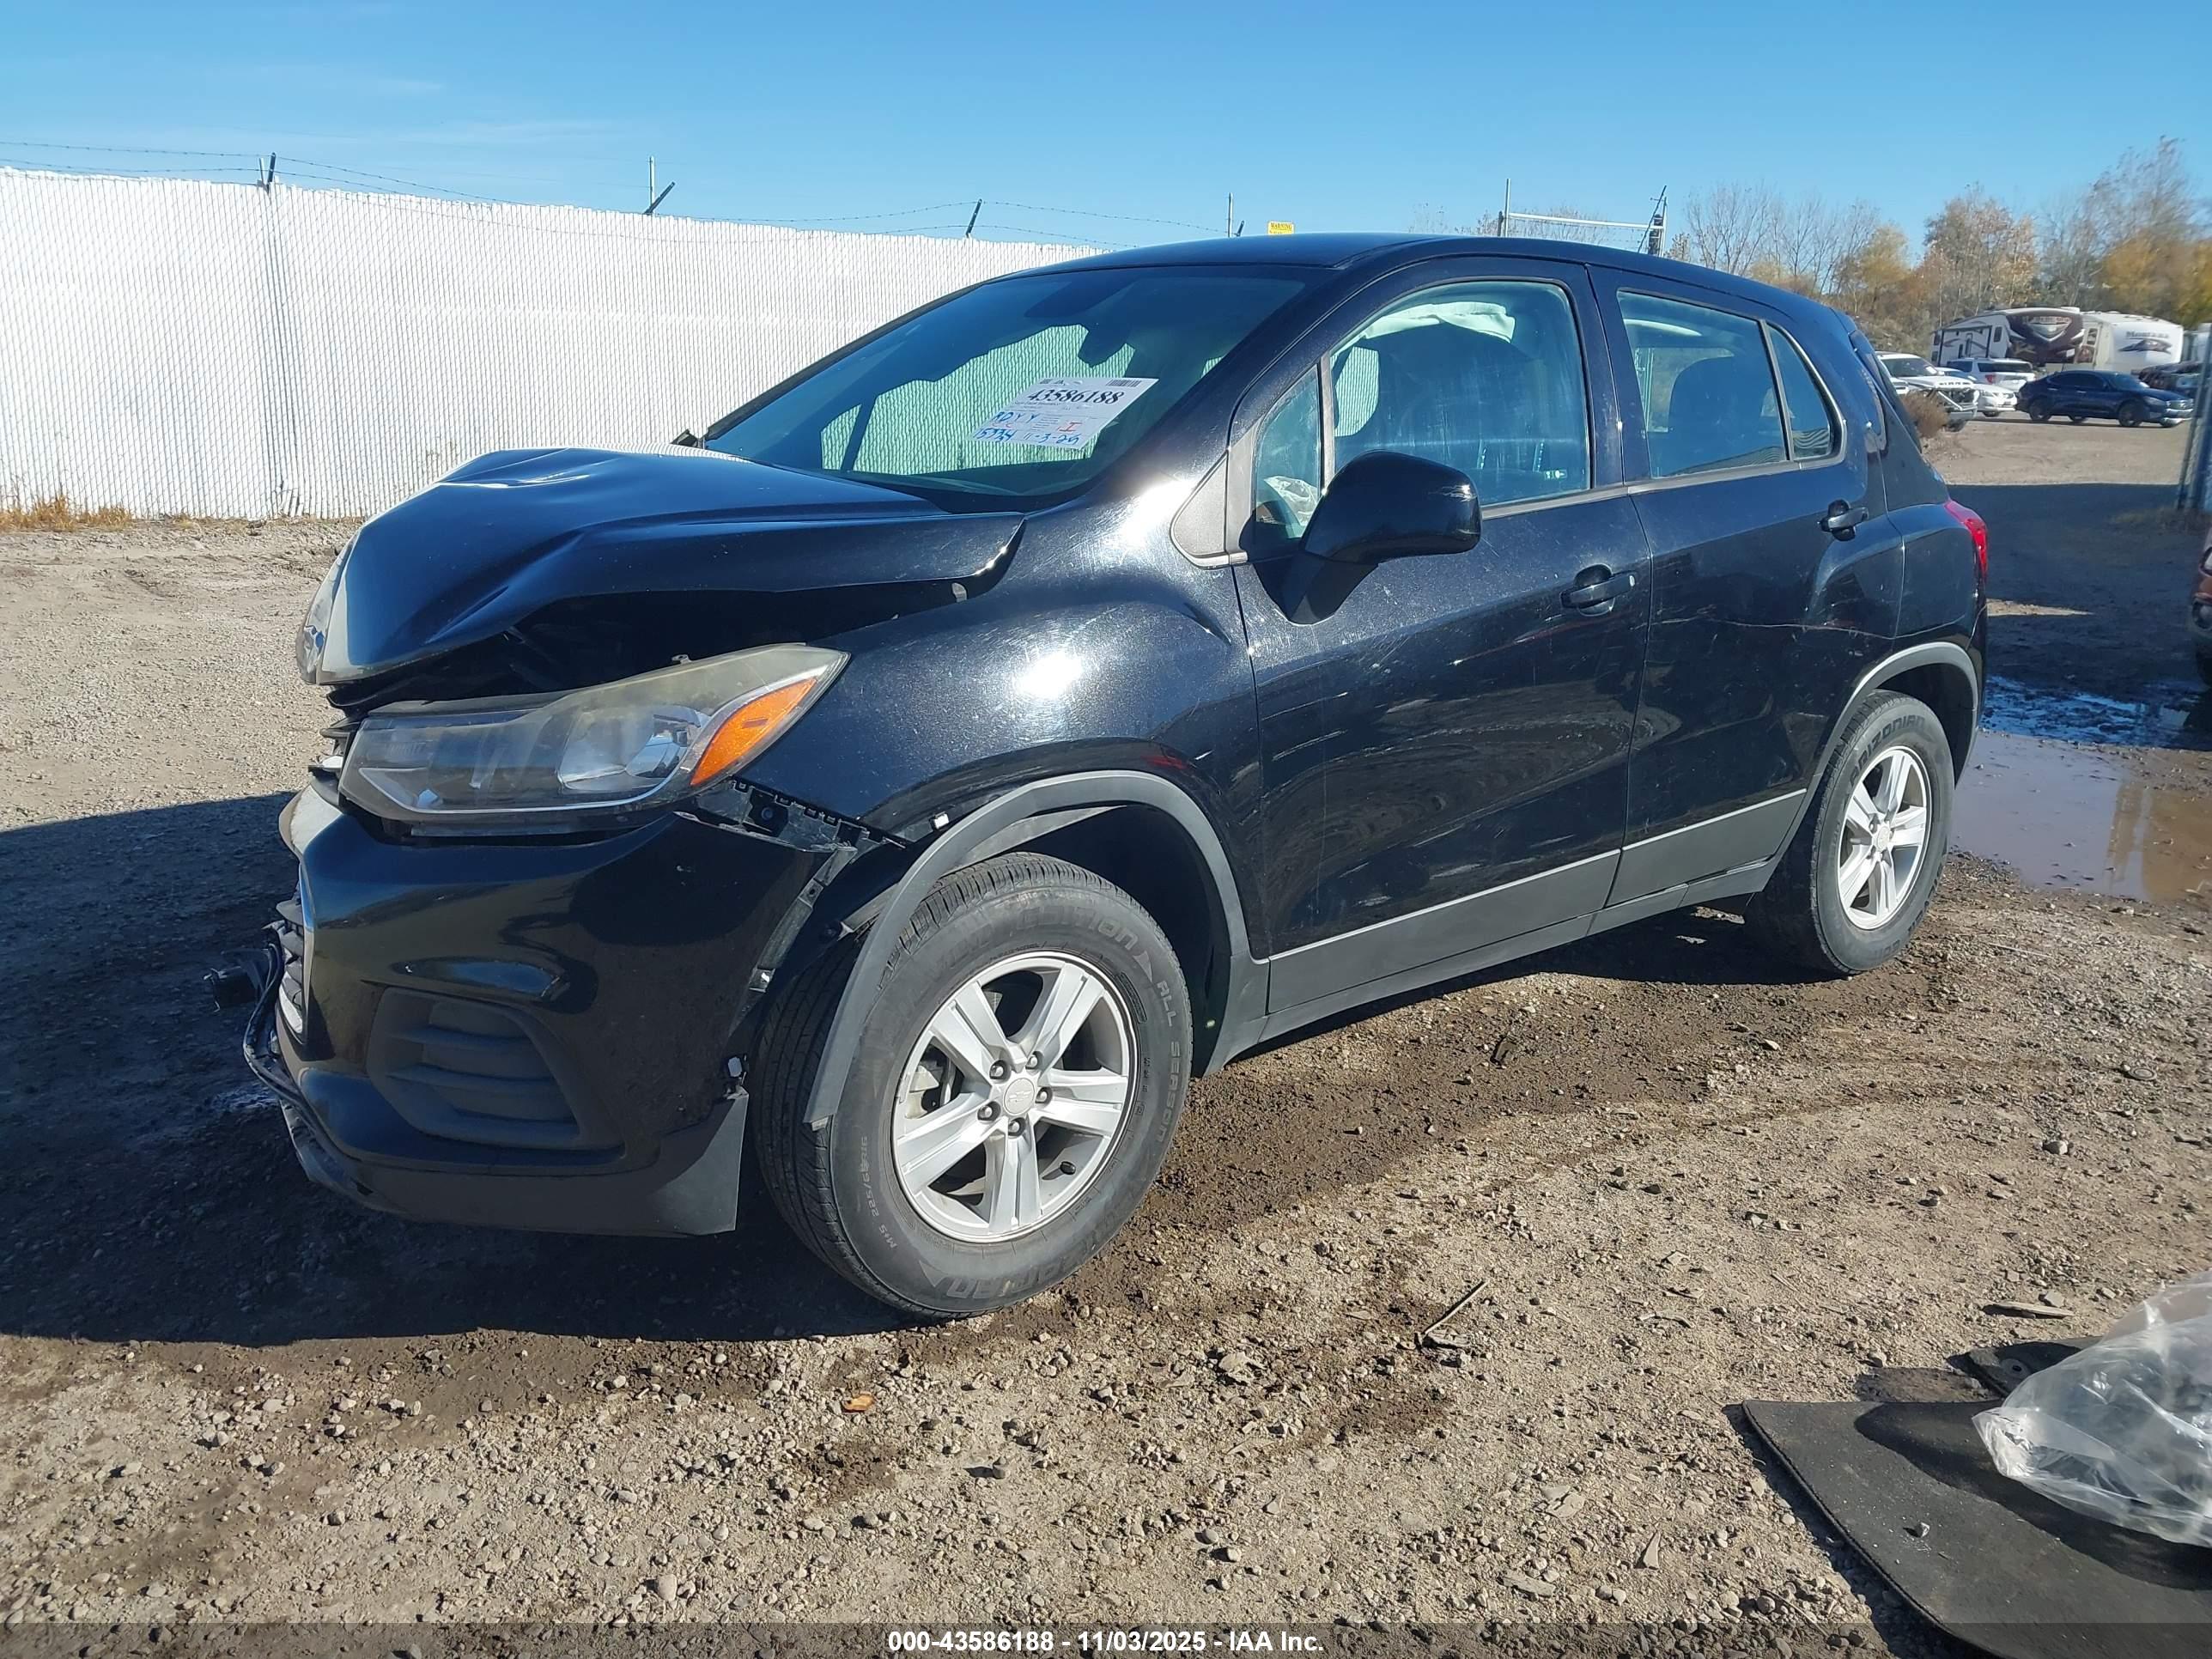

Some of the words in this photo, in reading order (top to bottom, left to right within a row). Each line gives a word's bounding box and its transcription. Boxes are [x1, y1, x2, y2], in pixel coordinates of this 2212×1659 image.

[1028, 388, 1124, 404] 43586188
[1156, 979, 1179, 1028] ALL
[1155, 1040, 1182, 1144] SEASON
